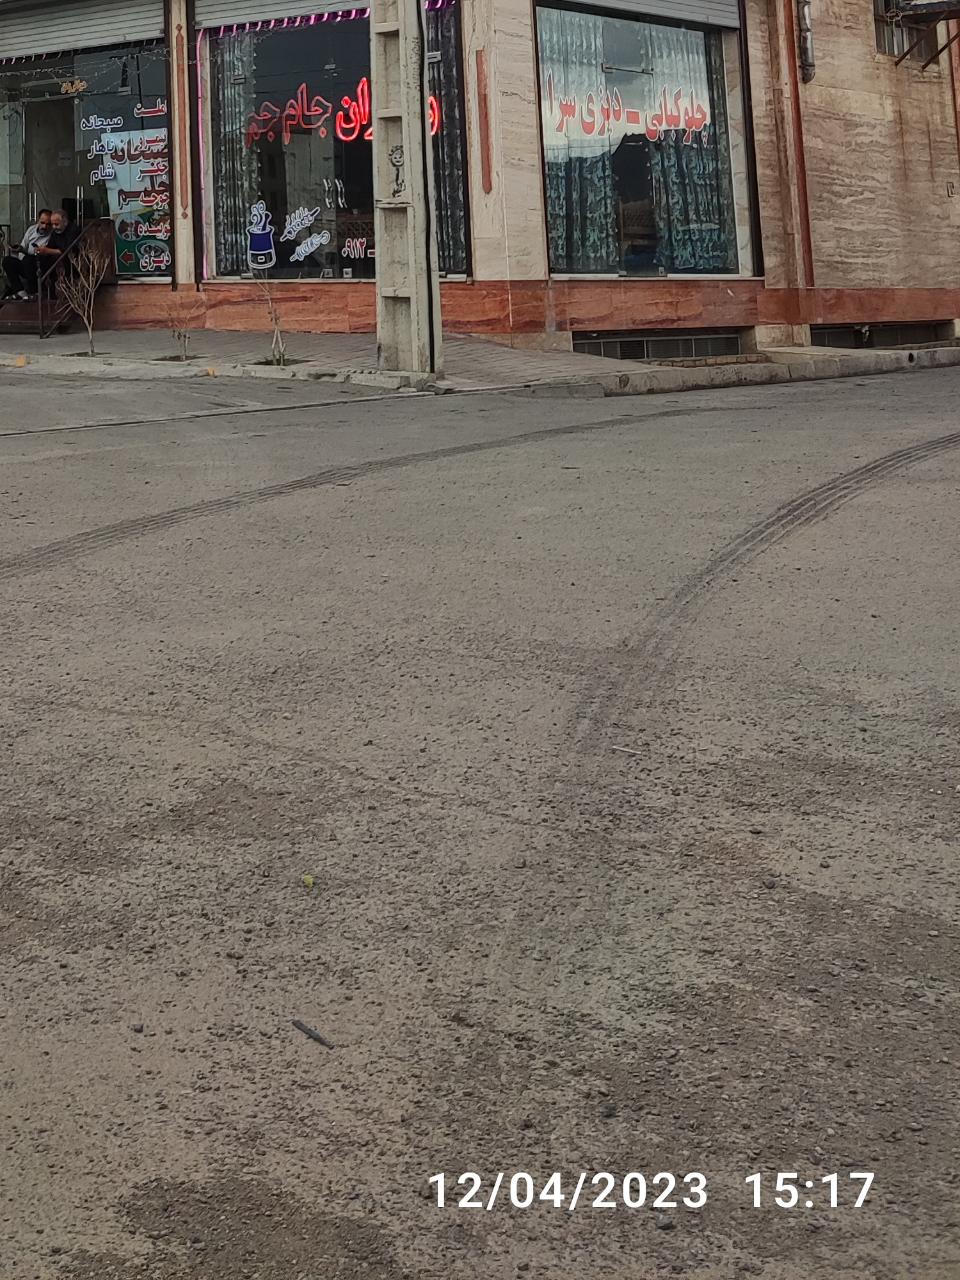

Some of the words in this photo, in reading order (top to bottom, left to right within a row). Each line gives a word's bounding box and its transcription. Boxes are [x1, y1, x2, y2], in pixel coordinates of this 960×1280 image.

[546, 68, 577, 134] سرا
[580, 84, 623, 137] دیزی
[81, 114, 123, 132] صبحانه
[245, 101, 281, 149] جم
[282, 82, 334, 145] جام
[87, 137, 115, 159] ناهار
[90, 162, 116, 185] شام
[138, 191, 170, 210] جوجه
[139, 250, 172, 271] دیزی
